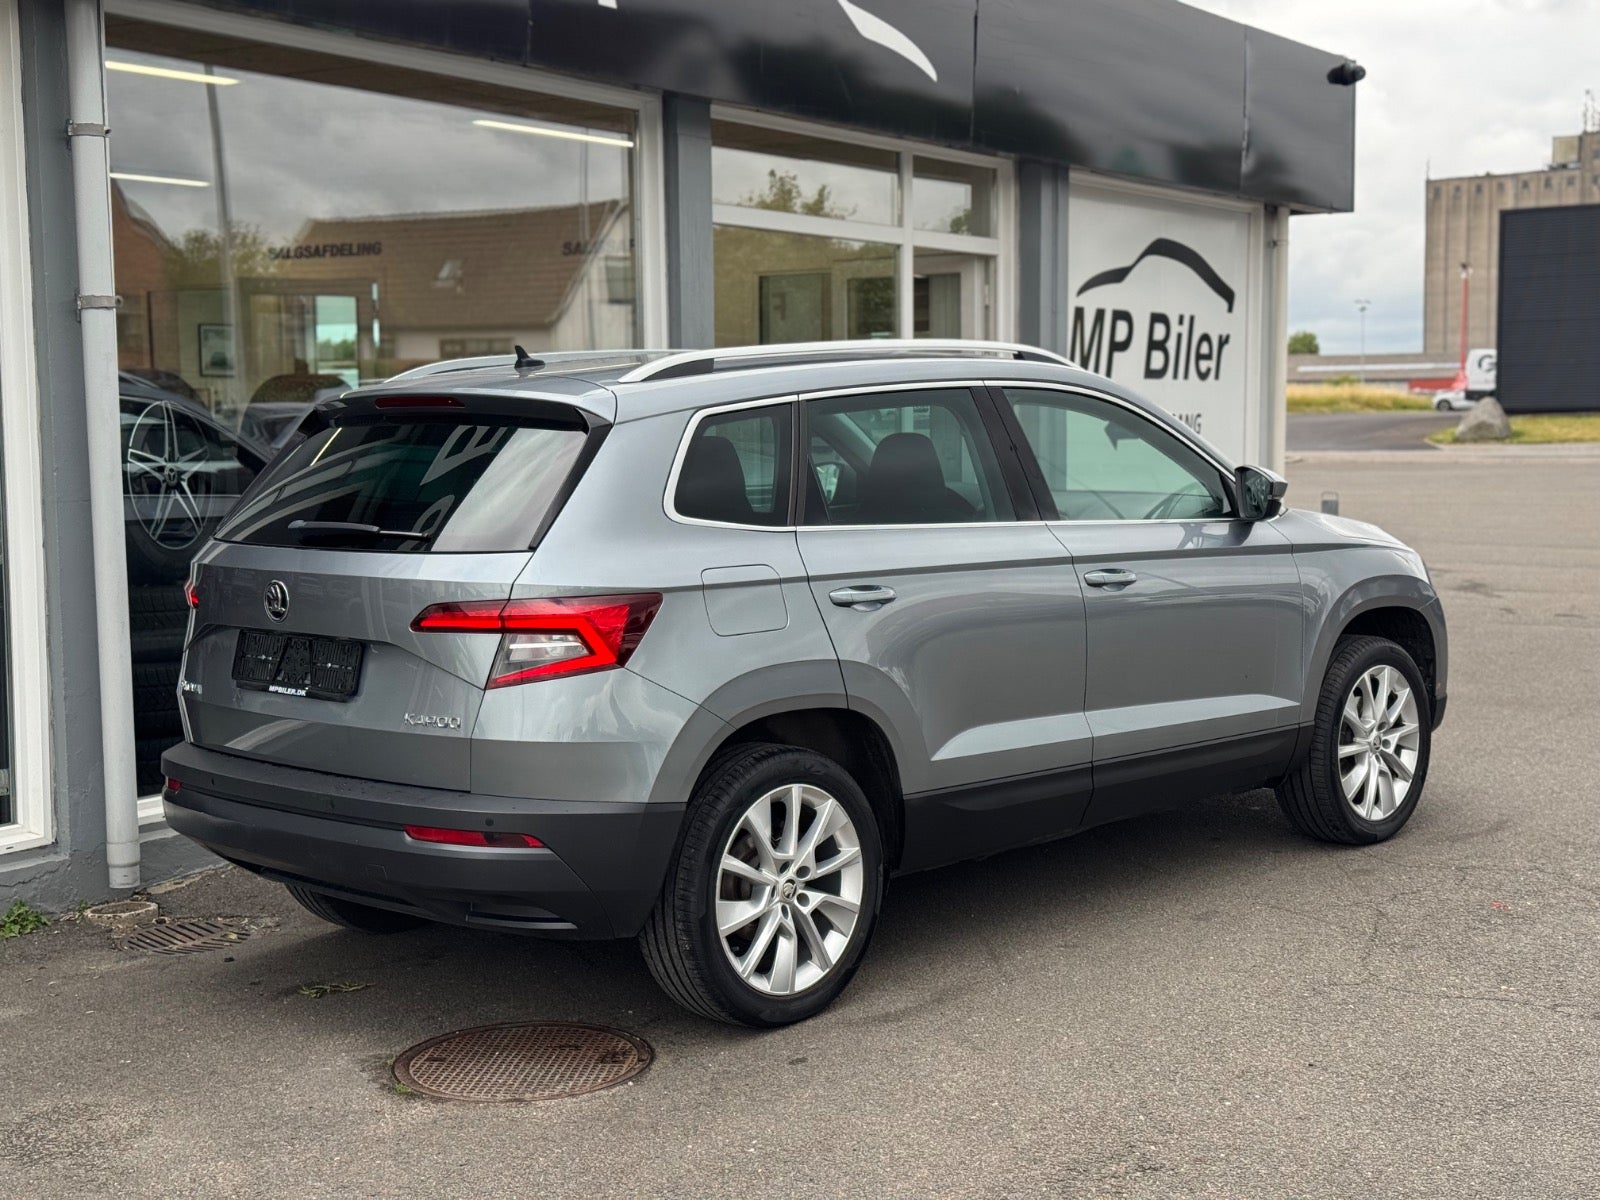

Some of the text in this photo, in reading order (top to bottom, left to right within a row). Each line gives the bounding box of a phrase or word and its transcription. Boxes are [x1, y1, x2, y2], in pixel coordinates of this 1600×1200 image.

[267, 242, 382, 260] SALGSAFDELING
[1069, 305, 1231, 382] MP Biler
[268, 684, 307, 697] MPBILER.DK
